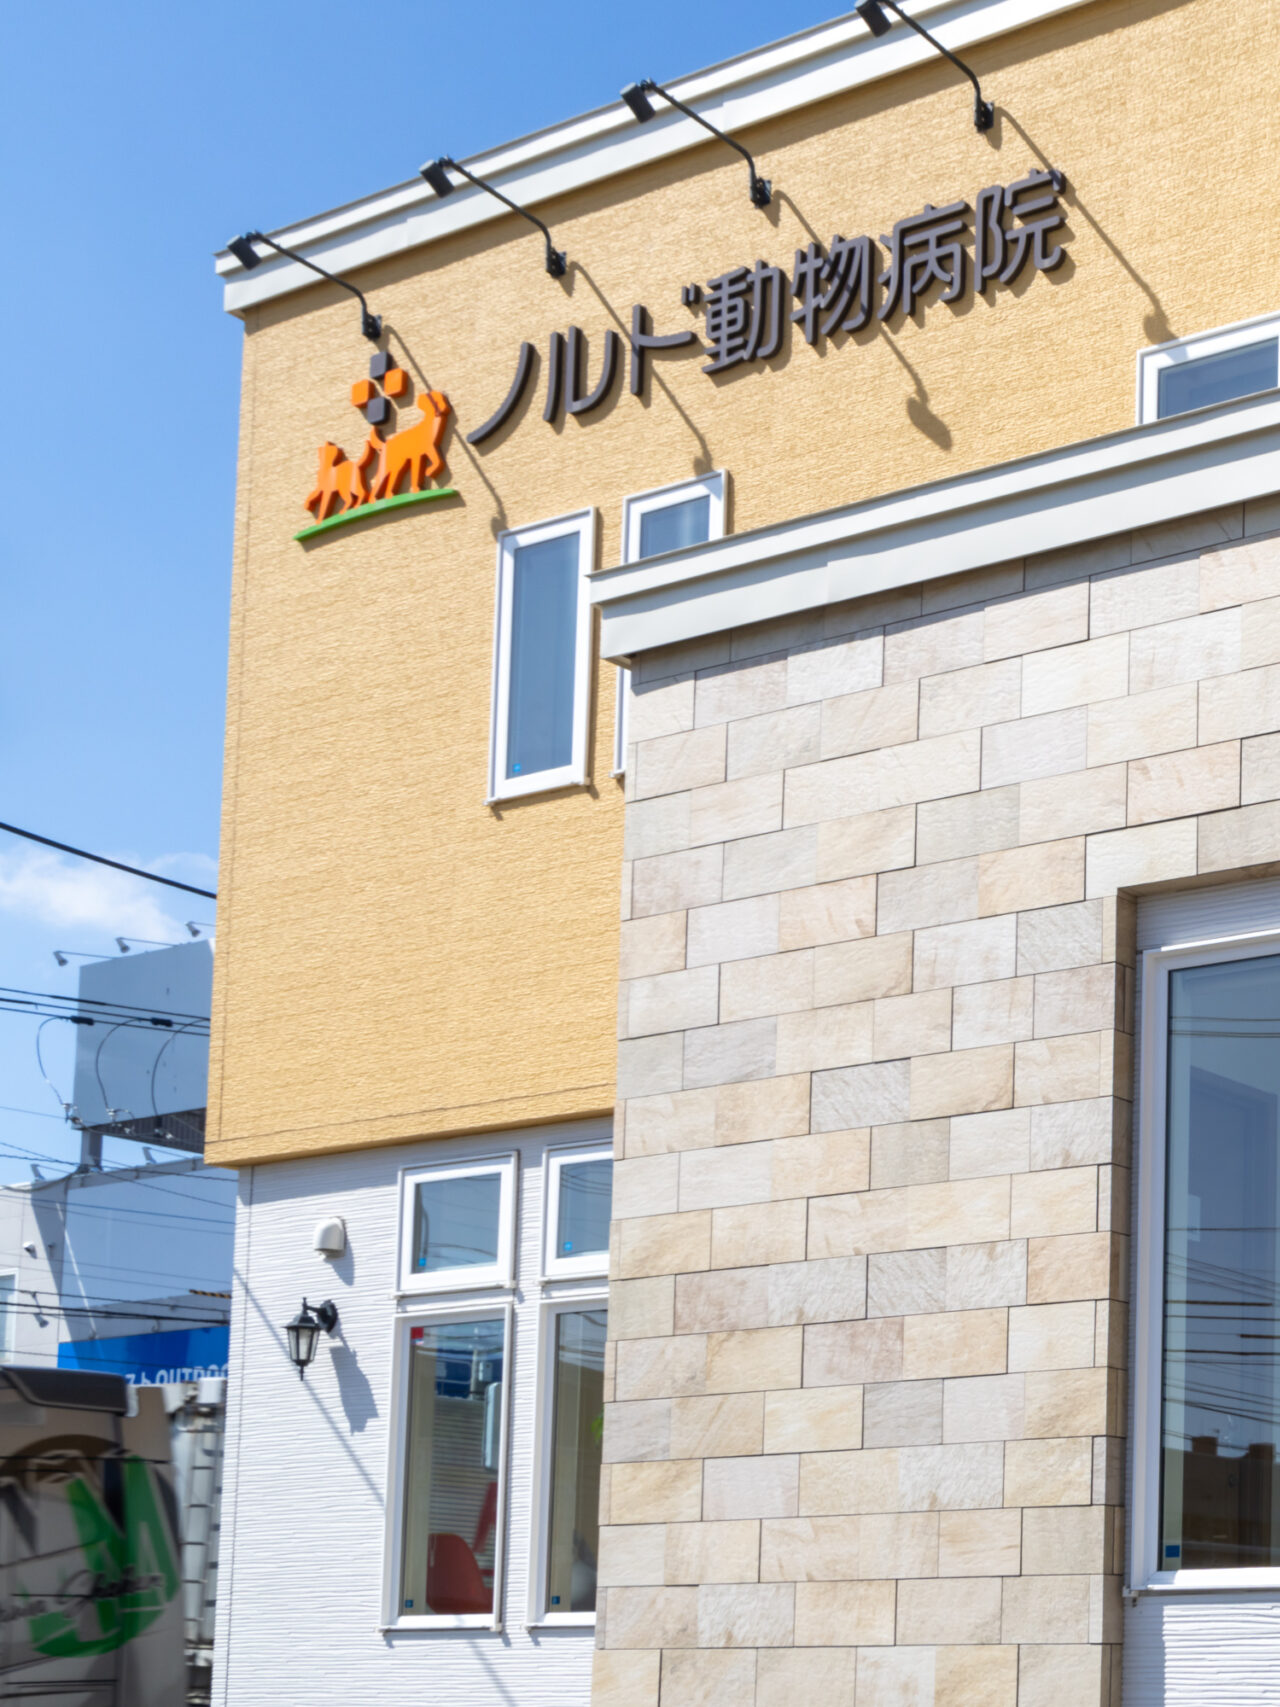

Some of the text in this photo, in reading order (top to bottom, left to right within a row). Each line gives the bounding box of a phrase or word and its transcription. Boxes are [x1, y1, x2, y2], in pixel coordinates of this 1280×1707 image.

[467, 168, 1067, 445] ノルド動物病院
